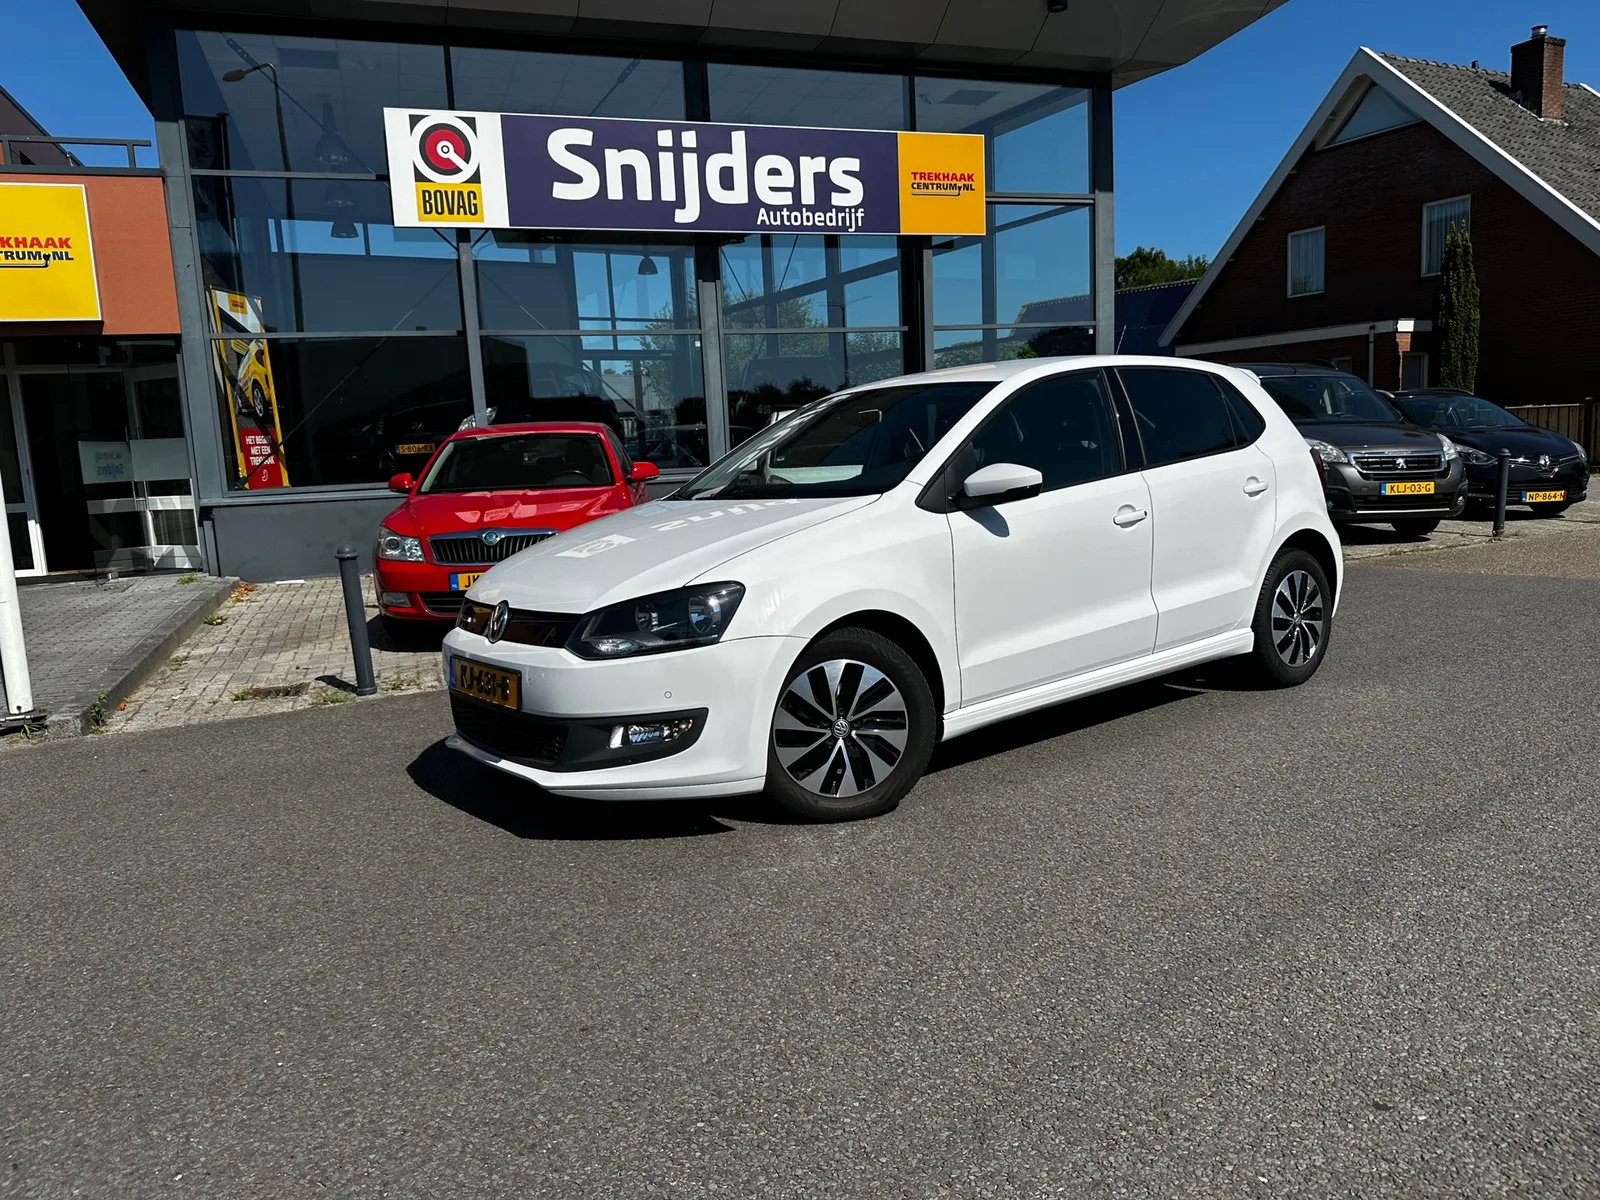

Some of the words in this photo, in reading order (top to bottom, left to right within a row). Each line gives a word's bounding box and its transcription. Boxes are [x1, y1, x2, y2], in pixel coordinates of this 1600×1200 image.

[547, 128, 864, 223] Snijders
[911, 172, 975, 182] TREKHAAK
[421, 189, 478, 216] BOVAG
[757, 207, 865, 232] Autobedrijf
[1390, 483, 1431, 494] KLJ-03-G
[1528, 492, 1566, 501] NP-864-N
